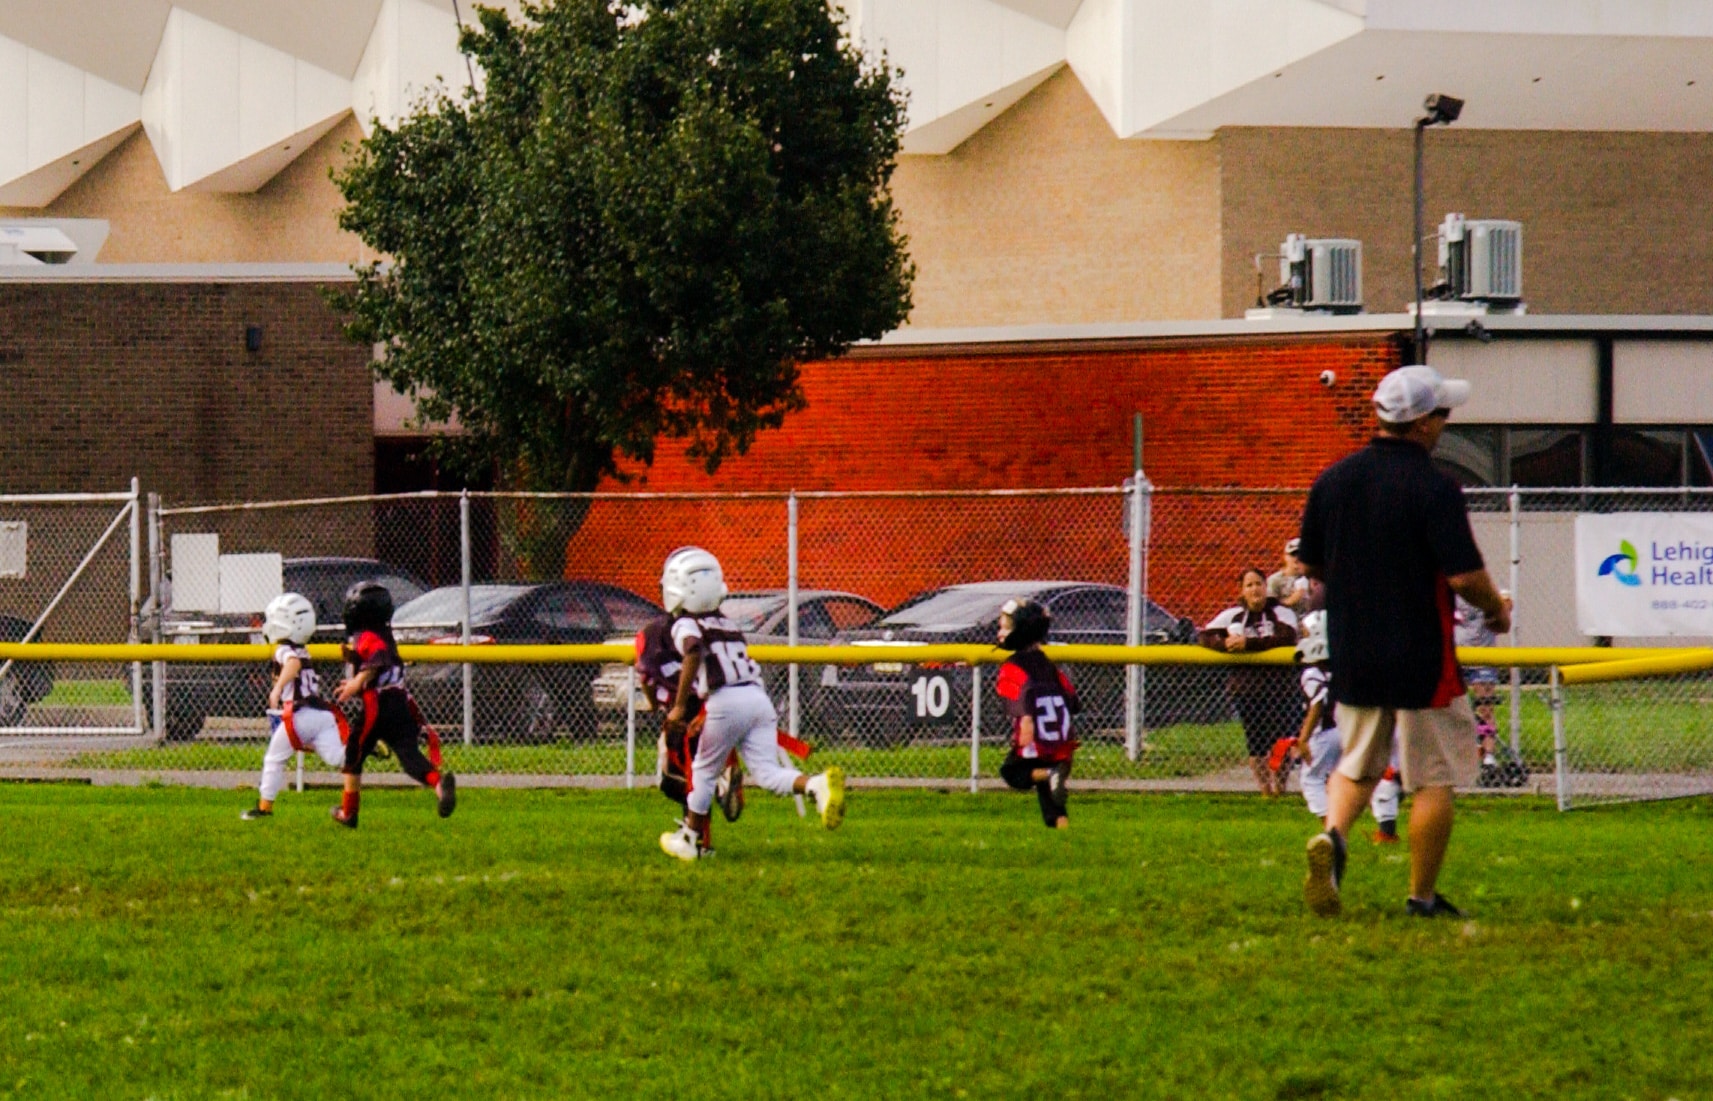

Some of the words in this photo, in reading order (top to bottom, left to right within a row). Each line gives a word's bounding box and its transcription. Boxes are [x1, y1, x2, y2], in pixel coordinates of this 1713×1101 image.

[1652, 541, 1713, 565] Lehig
[1652, 566, 1713, 585] Healt
[912, 675, 950, 717] 10
[1035, 695, 1071, 741] 27
